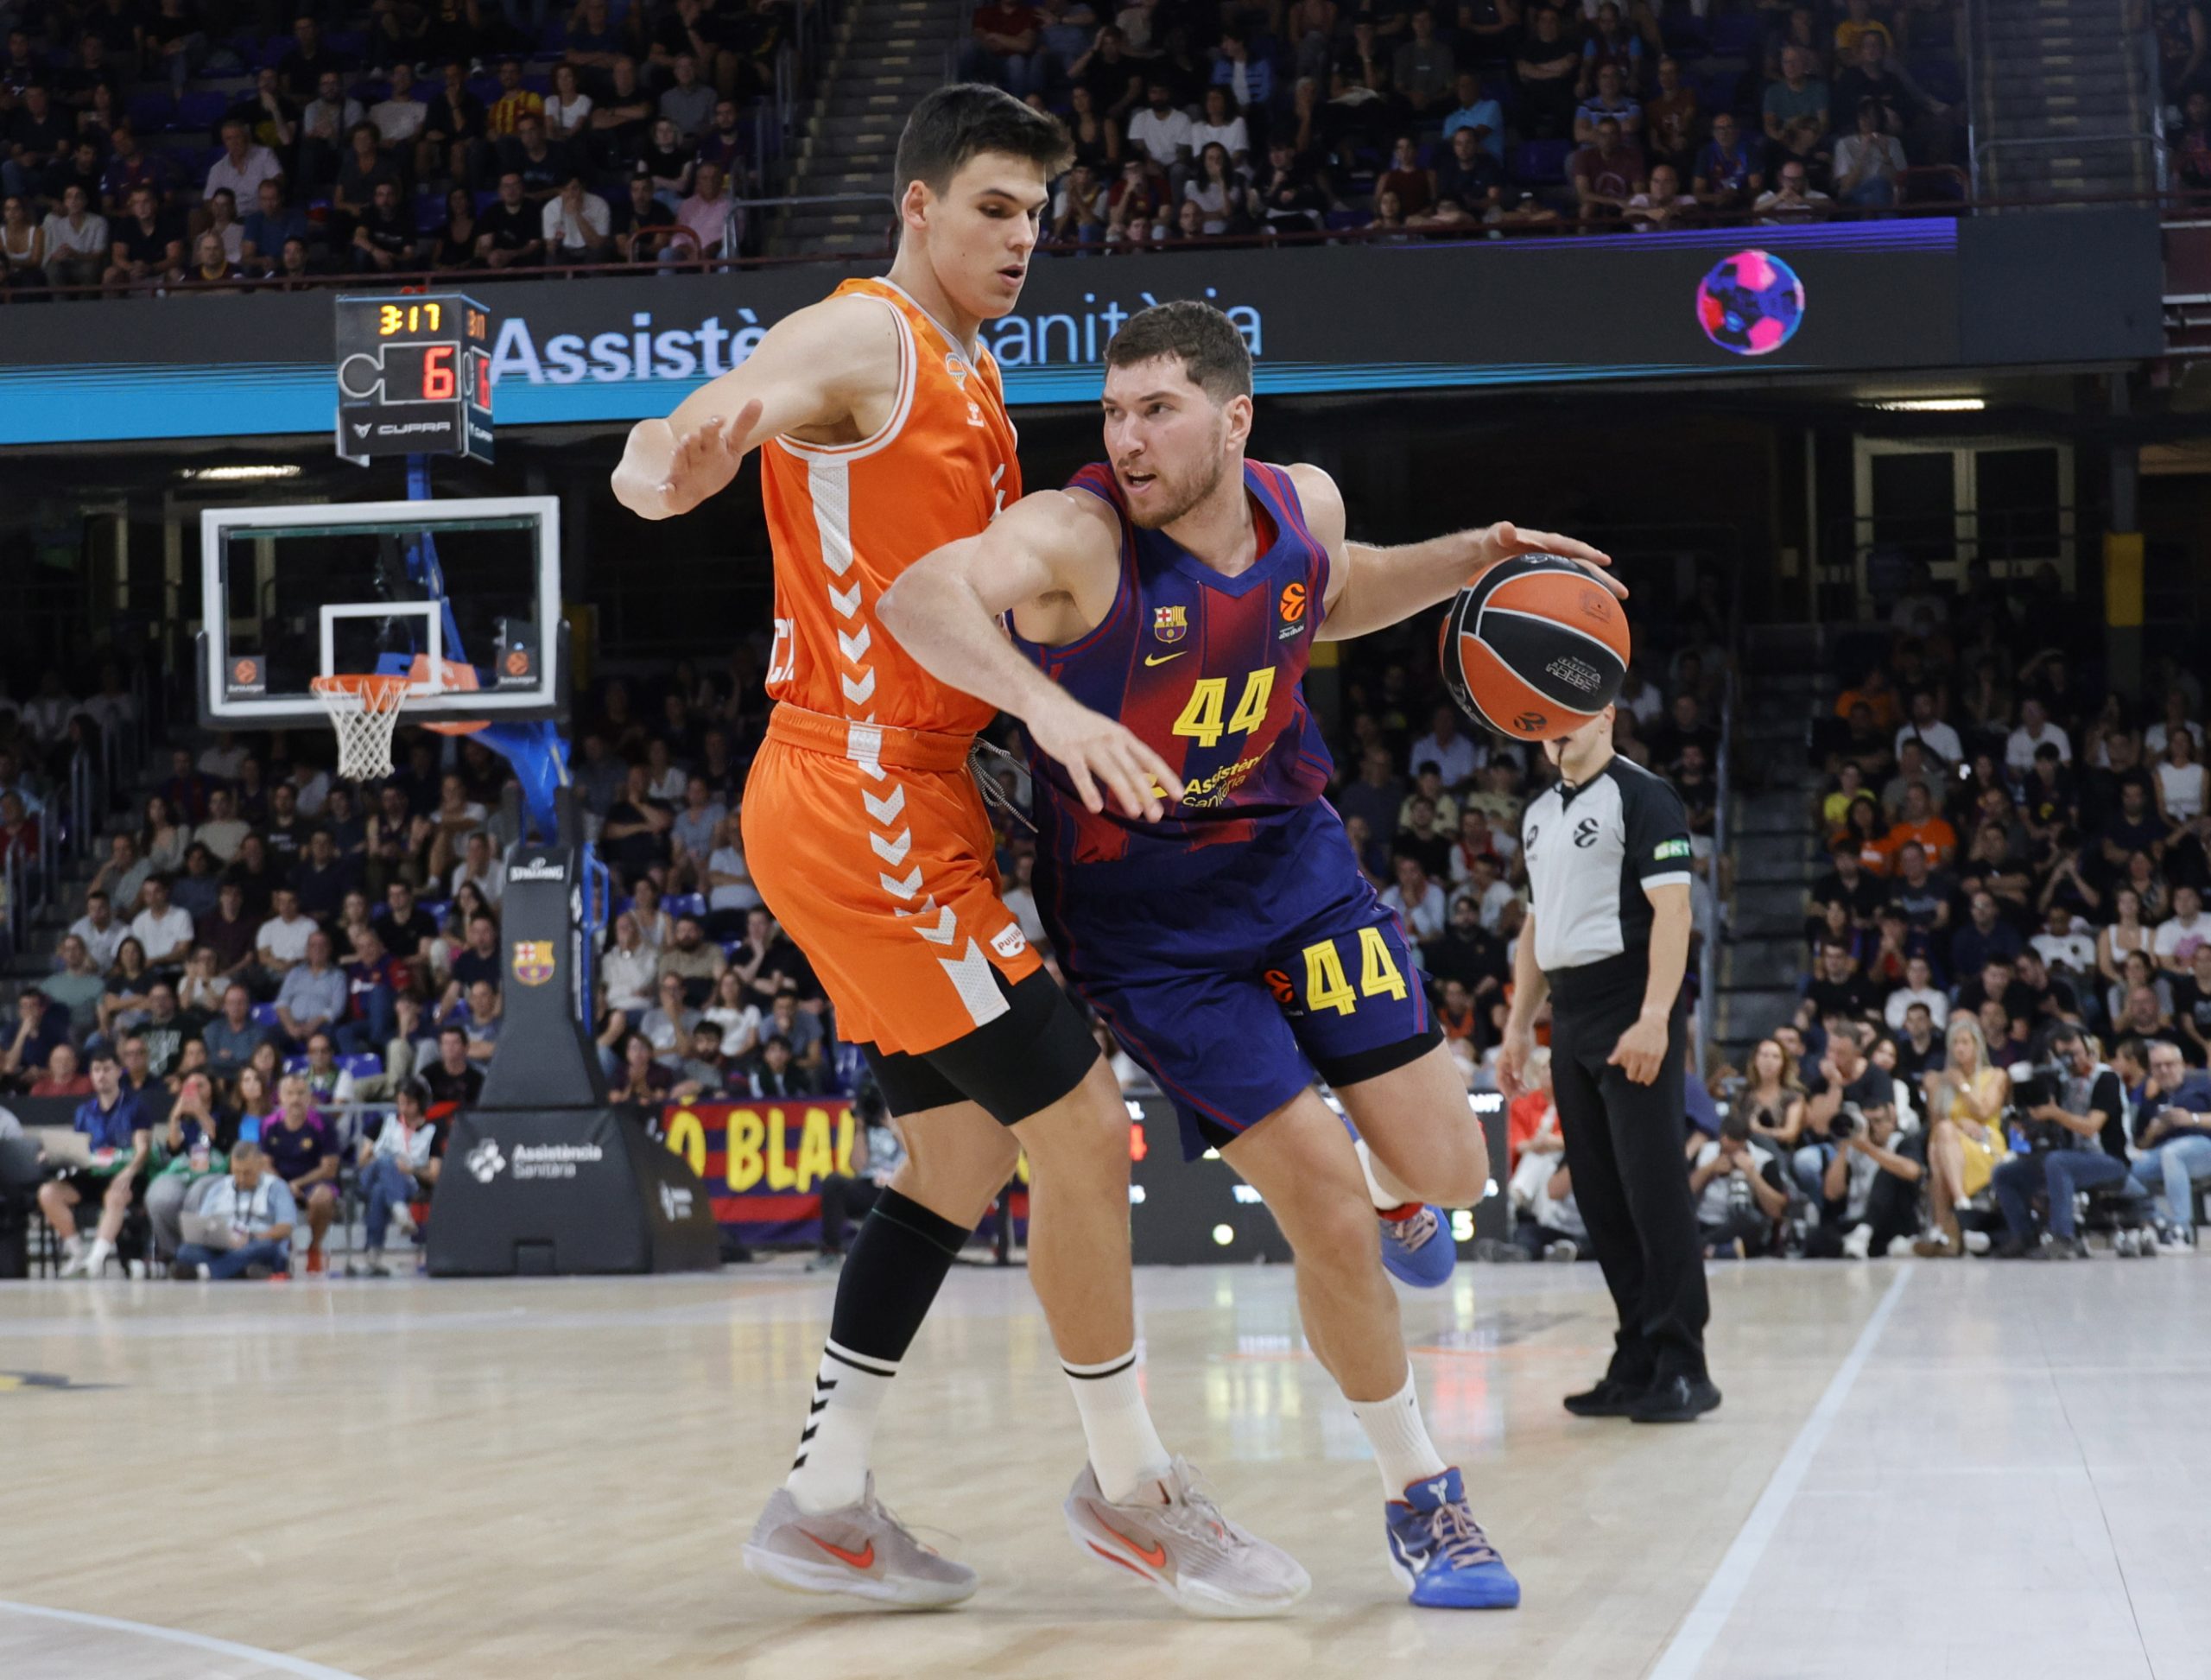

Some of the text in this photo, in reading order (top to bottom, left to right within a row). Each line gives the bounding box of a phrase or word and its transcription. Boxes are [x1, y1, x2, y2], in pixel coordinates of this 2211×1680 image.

[422, 347, 454, 399] 6
[377, 421, 451, 435] CUPRA
[1172, 666, 1276, 747] 44
[510, 865, 565, 882] SPALDING
[1302, 927, 1409, 1016] 44
